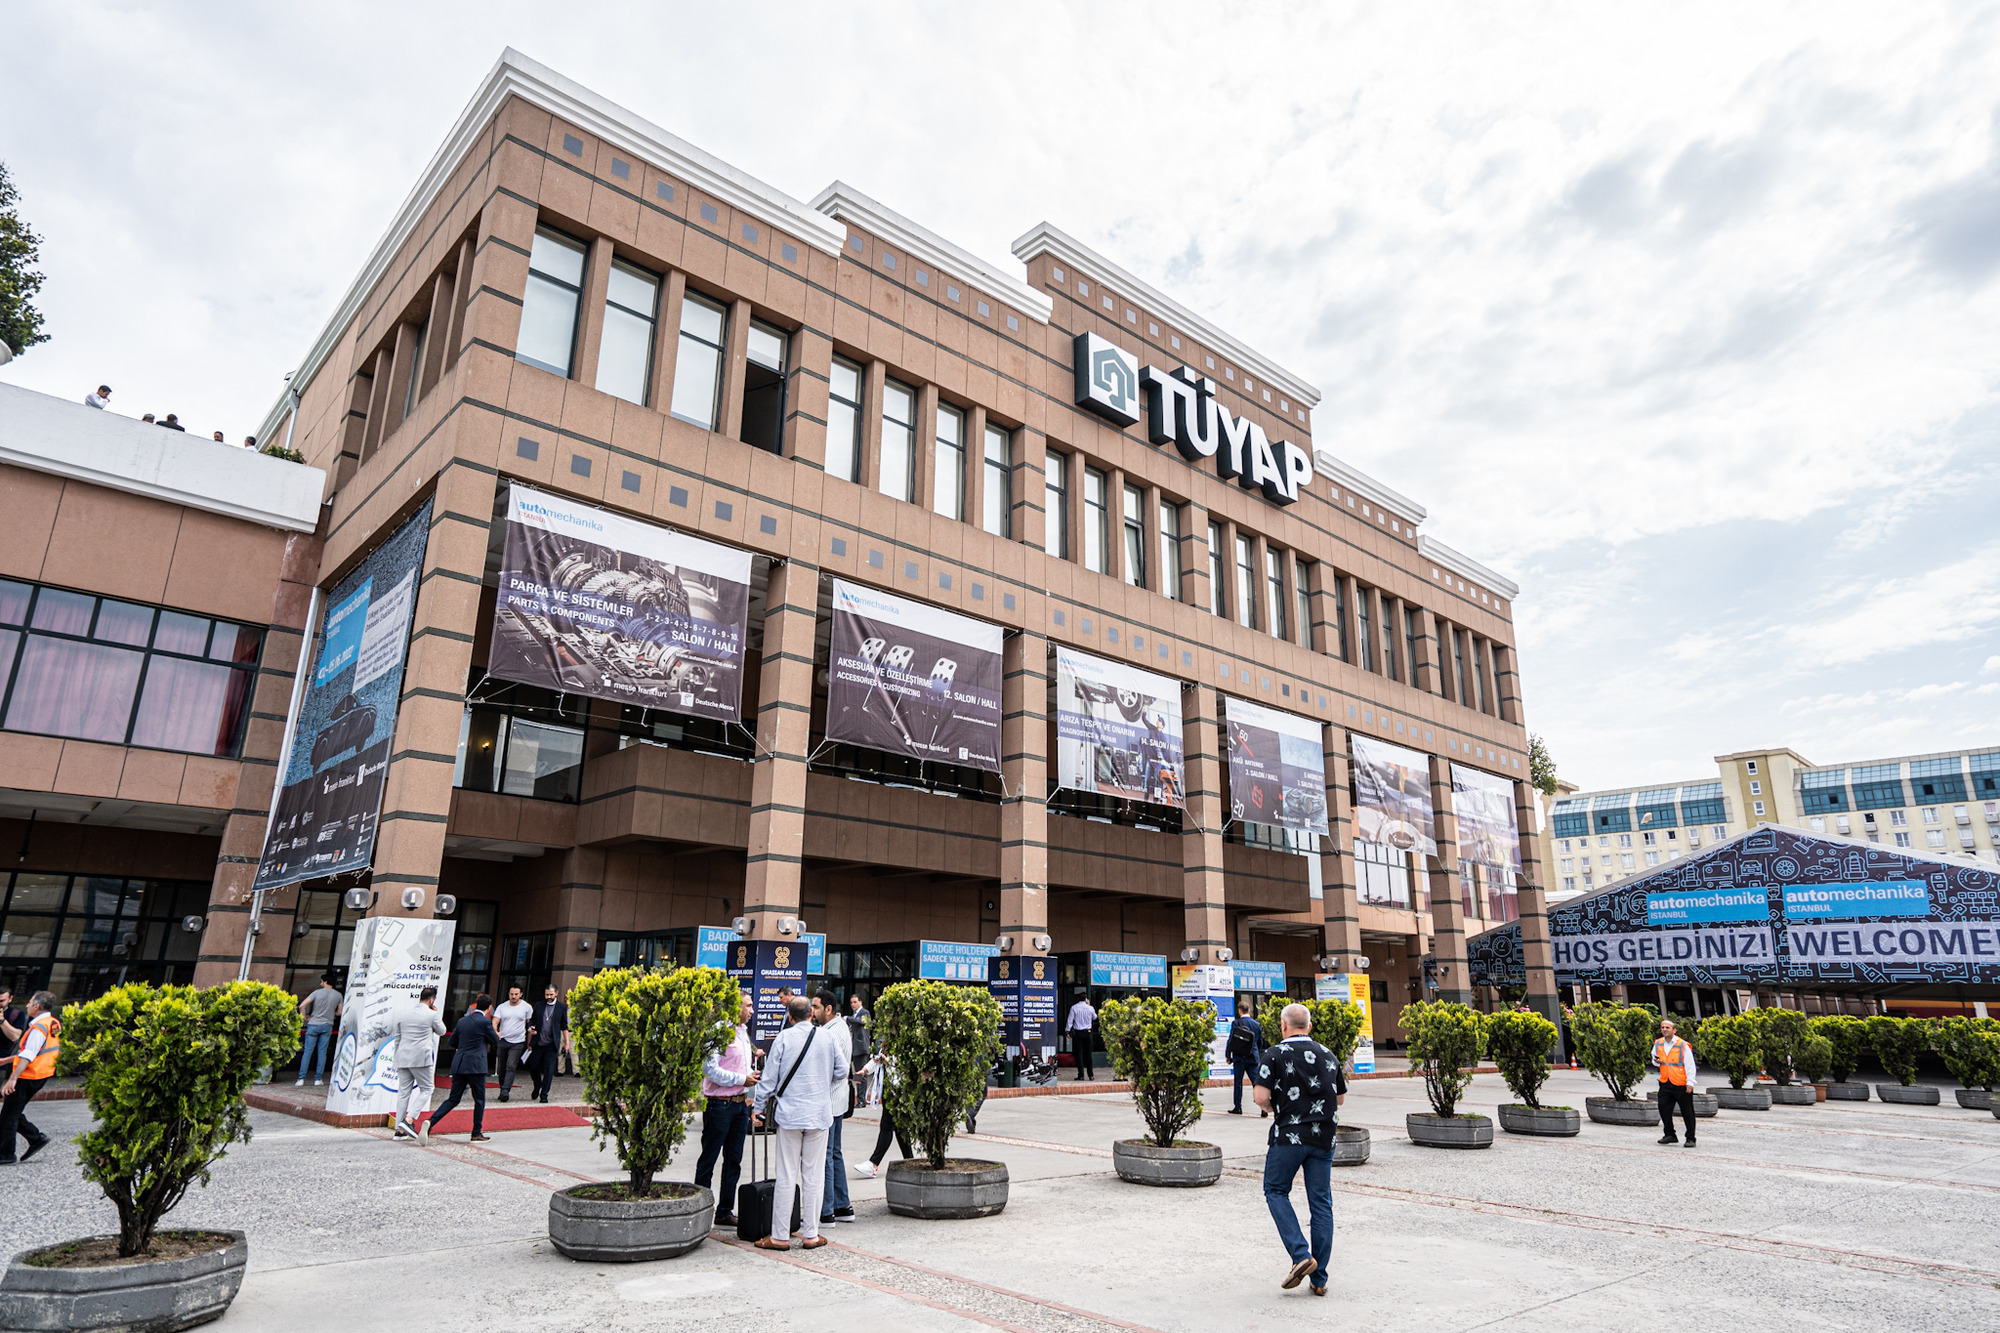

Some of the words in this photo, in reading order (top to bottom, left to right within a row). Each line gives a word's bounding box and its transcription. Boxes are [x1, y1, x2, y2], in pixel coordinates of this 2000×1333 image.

[1147, 364, 1313, 502] TÜYAP
[519, 501, 604, 531] automechanika
[510, 579, 549, 597] PARÇA
[553, 589, 568, 602] VE
[571, 594, 634, 617] SİSTEMLER
[508, 595, 539, 610] PARTS
[550, 606, 615, 627] COMPONENTS
[671, 630, 706, 646] SALON
[714, 640, 739, 654] HALL
[837, 657, 875, 673] AKSESUAR
[875, 666, 885, 677] VE
[886, 667, 933, 689] ÖZELLEŞTİRME
[613, 681, 637, 693] messe
[638, 685, 668, 698] frankfurt
[836, 671, 877, 687] ACCESSORIES
[882, 682, 921, 698] CUSTOMIZING
[695, 698, 719, 708] Deutsche
[719, 702, 735, 712] Messe
[943, 689, 953, 699] 12.
[954, 692, 977, 705] SALON
[981, 698, 998, 710] HALL
[1059, 714, 1080, 725] ARIZA
[1103, 723, 1111, 731] VE
[1111, 724, 1136, 737] ONARIM
[1059, 726, 1095, 739] DIAGNOSTICS
[1149, 739, 1166, 749] SALON
[1233, 798, 1245, 818] 20
[1649, 891, 1765, 910] automechanika
[1786, 885, 1925, 903] automechanika
[1650, 910, 1688, 920] ISTANBUL
[1787, 904, 1833, 913] ISTANBUL
[927, 944, 954, 954] BADGE
[955, 946, 991, 956] HOLDERS
[1554, 940, 1609, 969] HOŞ
[1617, 929, 1768, 962] GELDİNİZ!
[1791, 928, 2000, 956] WELCOME
[923, 954, 948, 963] SADECE
[966, 957, 984, 965] KARTI
[1093, 963, 1112, 971] SADECE
[1095, 954, 1117, 963] BADGE
[1117, 955, 1146, 965] HOLDERS
[1146, 957, 1162, 965] ONLY
[1245, 962, 1268, 971] HOLDERS
[1269, 963, 1281, 971] ONLY
